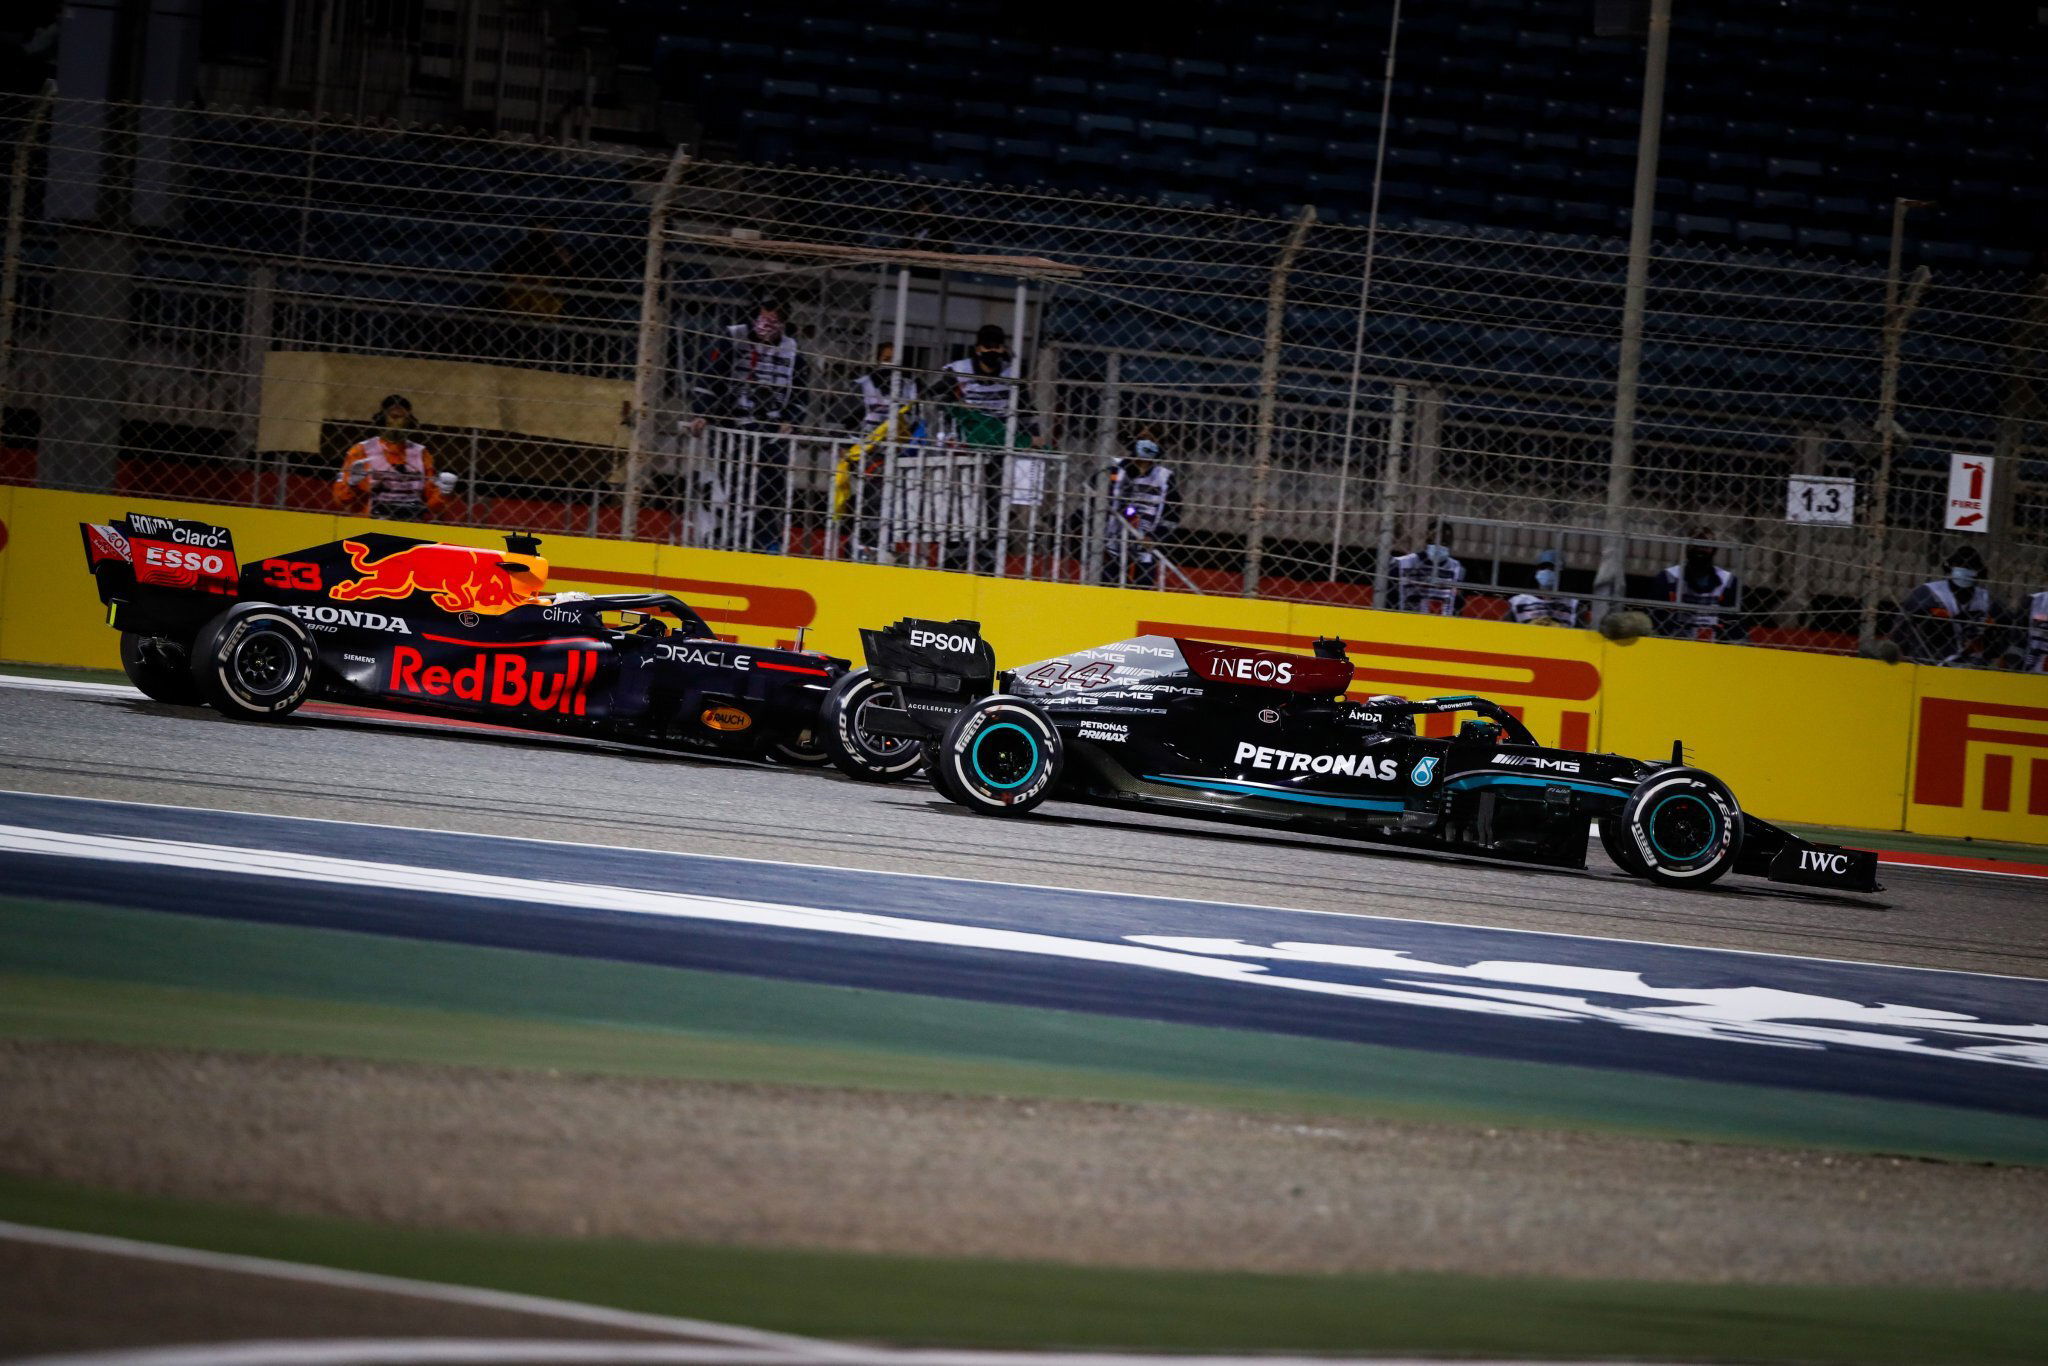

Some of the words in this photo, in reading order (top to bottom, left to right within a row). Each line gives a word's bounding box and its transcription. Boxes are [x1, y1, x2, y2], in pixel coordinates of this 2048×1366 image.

[1800, 486, 1842, 514] 1.3
[1951, 499, 1982, 510] FIRE
[146, 547, 224, 574] ESSO
[262, 559, 323, 591] 33
[290, 605, 412, 635] HONDA
[542, 607, 582, 624] citrix
[304, 622, 338, 633] BRID
[910, 629, 976, 654] EPSON
[343, 653, 376, 664] SIEMENS
[656, 643, 752, 671] ORACLE
[1123, 644, 1175, 658] AMG
[1026, 661, 1115, 689] 44
[1137, 668, 1189, 678] AMG
[1210, 657, 1293, 685] INEOS
[389, 645, 486, 704] Red
[490, 649, 598, 717] Bull
[1102, 690, 1154, 701] AMG
[1151, 684, 1204, 696] AMG
[908, 703, 952, 714] ACCELERATE
[1048, 696, 1099, 705] AMG
[1348, 709, 1373, 722] AMD
[1080, 720, 1128, 733] PETRONAS
[1077, 729, 1130, 743] PRIMAX
[1234, 741, 1399, 782] PETRONAS
[1519, 757, 1580, 773] AMG
[1707, 790, 1733, 848] ZERO
[1799, 850, 1849, 874] IWC
